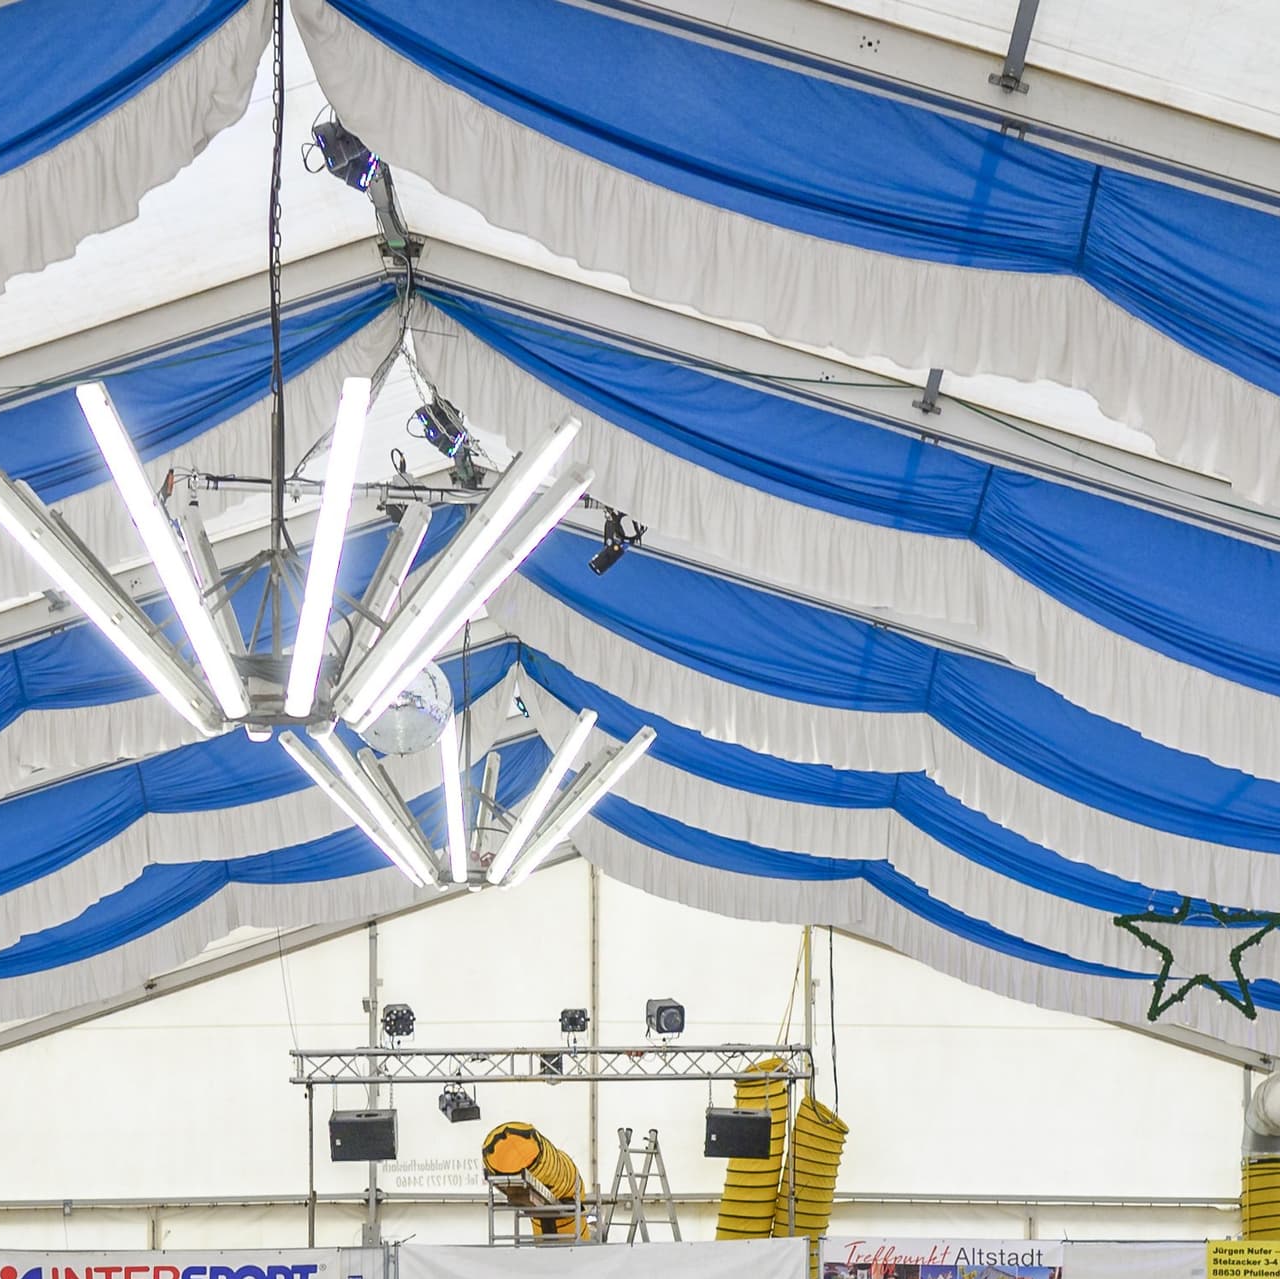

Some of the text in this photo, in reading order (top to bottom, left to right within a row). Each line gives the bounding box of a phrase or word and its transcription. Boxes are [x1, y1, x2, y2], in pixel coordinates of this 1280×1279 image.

[1212, 1247, 1245, 1256] Jürgen
[1247, 1247, 1272, 1256] Nufer
[845, 1241, 1043, 1275] Treffpunkt Altstadt
[1212, 1258, 1261, 1266] Stelzacker
[1212, 1268, 1241, 1277] 88630
